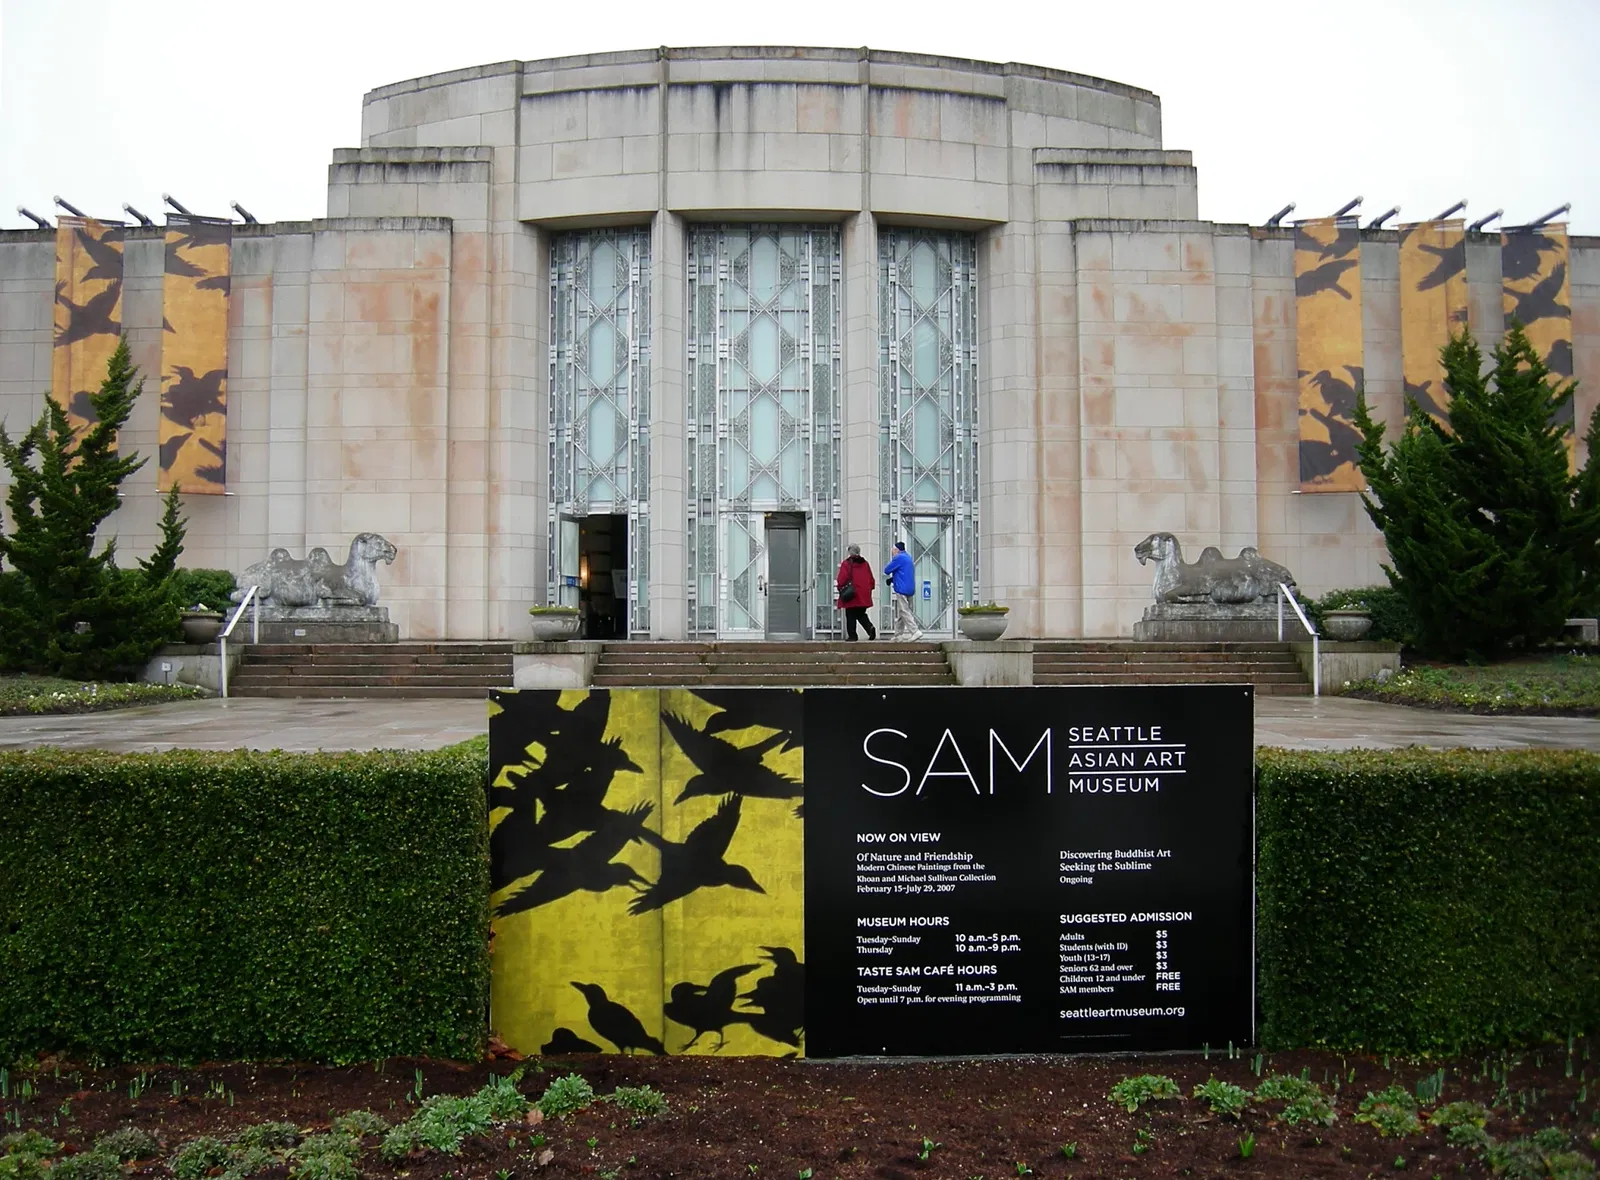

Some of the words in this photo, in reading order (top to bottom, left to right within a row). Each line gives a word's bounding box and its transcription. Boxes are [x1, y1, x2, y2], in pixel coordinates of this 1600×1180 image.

[1069, 726, 1161, 742] SEATTLE
[862, 728, 1051, 796] SAM
[1069, 752, 1134, 767] ASIAN
[1144, 752, 1185, 766] ART
[1070, 778, 1158, 793] MUSEUM
[857, 833, 886, 842] NOW
[889, 833, 907, 842] ON
[910, 833, 940, 842] VIEW
[857, 853, 869, 861] Of
[870, 853, 902, 861] Nature
[904, 852, 921, 861] and
[924, 852, 973, 863] Friendship
[1060, 850, 1112, 860] Discovering
[1115, 849, 1154, 858] Buddhist
[1157, 849, 1171, 857] Art
[918, 863, 951, 871] Paintings
[953, 862, 971, 870] from
[1060, 862, 1095, 872] Seeking
[1098, 862, 1112, 870] the
[1115, 861, 1152, 870] Sublime
[1060, 875, 1092, 884] Ongoing
[857, 885, 892, 894] February
[858, 917, 906, 927] MUSEUM
[910, 917, 949, 926] HOURS
[1060, 913, 1127, 923] SUGGESTED
[1130, 912, 1192, 922] ADMISSION
[955, 934, 966, 942] 10
[1156, 930, 1167, 938] $5
[856, 946, 893, 955] Thursday
[955, 944, 966, 952] 10
[1095, 943, 1114, 951] (with
[1117, 943, 1128, 951] ID)
[1156, 941, 1167, 949] $3
[1060, 954, 1082, 962] Youth
[1156, 951, 1167, 960] $3
[857, 967, 892, 976] TASTE
[896, 967, 920, 976] SAM
[924, 964, 954, 975] CAFÉ
[958, 965, 997, 974] HOURS
[1156, 962, 1167, 970] $3
[1060, 975, 1093, 983] Children
[1156, 972, 1180, 980] FREE
[955, 983, 963, 991] 11
[998, 984, 1017, 992] p.m.
[1079, 985, 1114, 993] members
[1156, 982, 1180, 991] FREE
[857, 996, 877, 1005] Open
[937, 995, 967, 1003] evening
[969, 994, 1021, 1003] programming
[1060, 1007, 1185, 1018] seattleartmuseum.org
